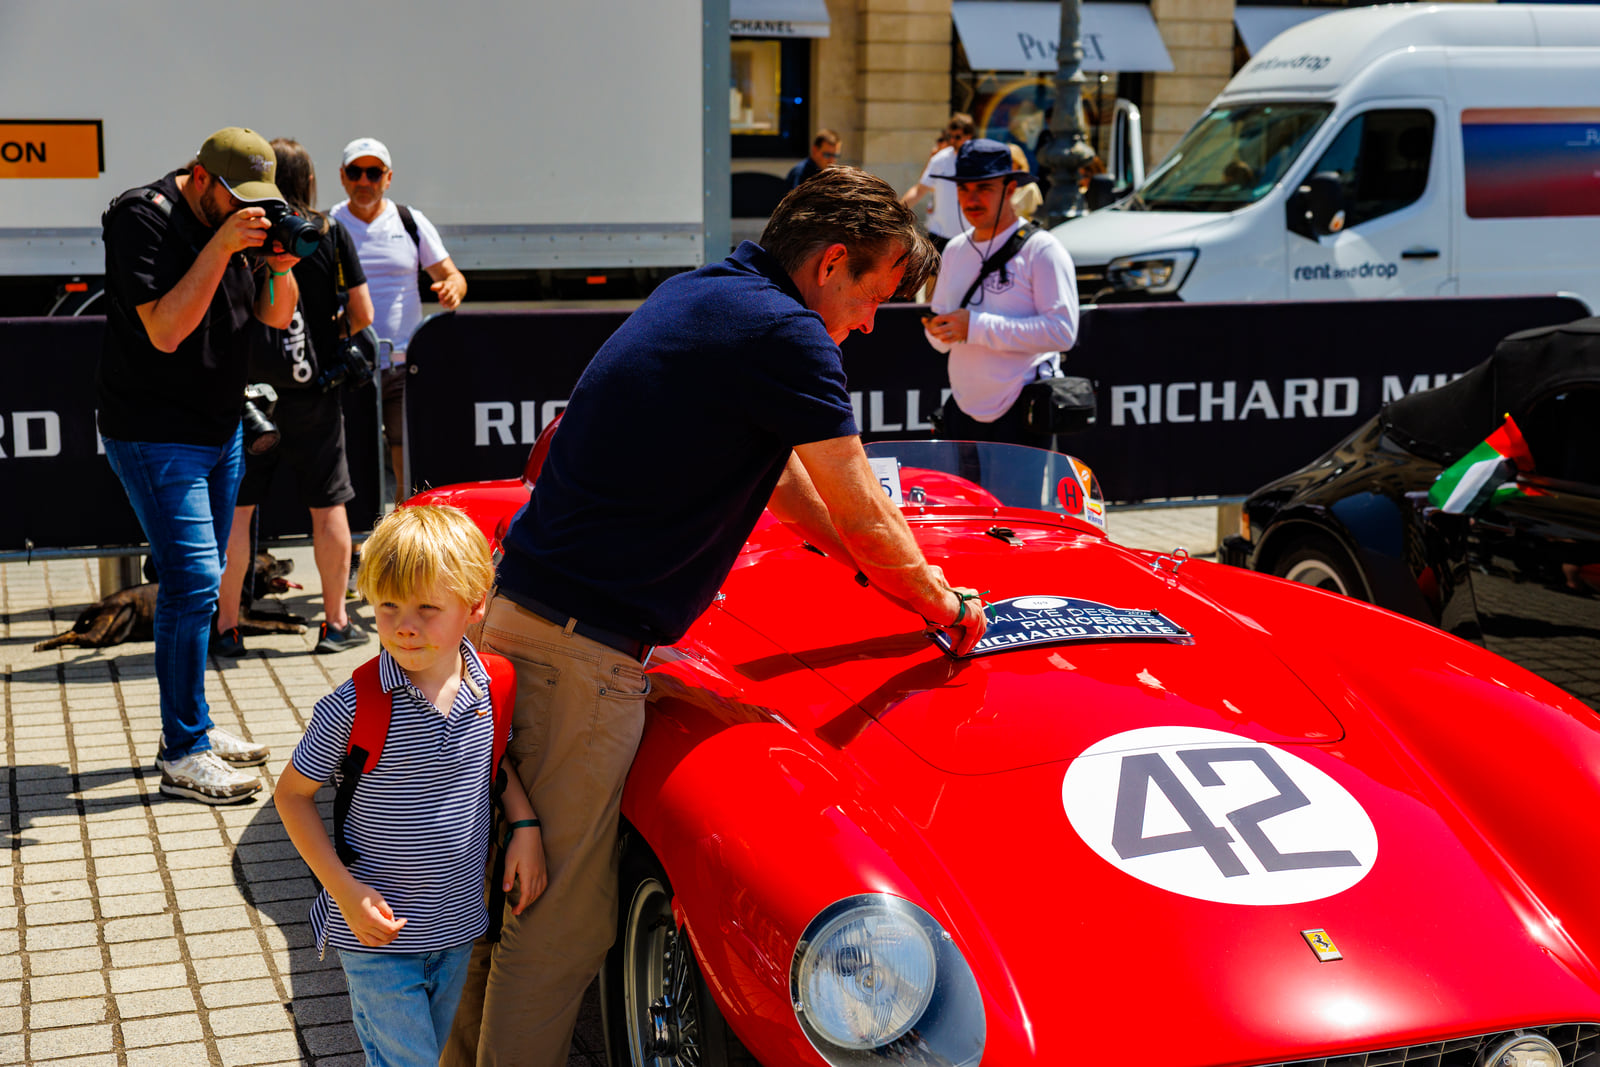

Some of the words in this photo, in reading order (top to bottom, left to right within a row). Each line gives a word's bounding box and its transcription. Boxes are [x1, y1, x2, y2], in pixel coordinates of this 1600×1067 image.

[729, 20, 795, 33] CHANEL
[0, 141, 47, 163] ON
[1111, 377, 1360, 426] RICHARD
[1063, 482, 1078, 509] H
[1066, 608, 1116, 617] DES
[1020, 616, 1165, 630] PRINCESSES
[1093, 625, 1177, 635] MILLE
[1111, 747, 1362, 878] 42
